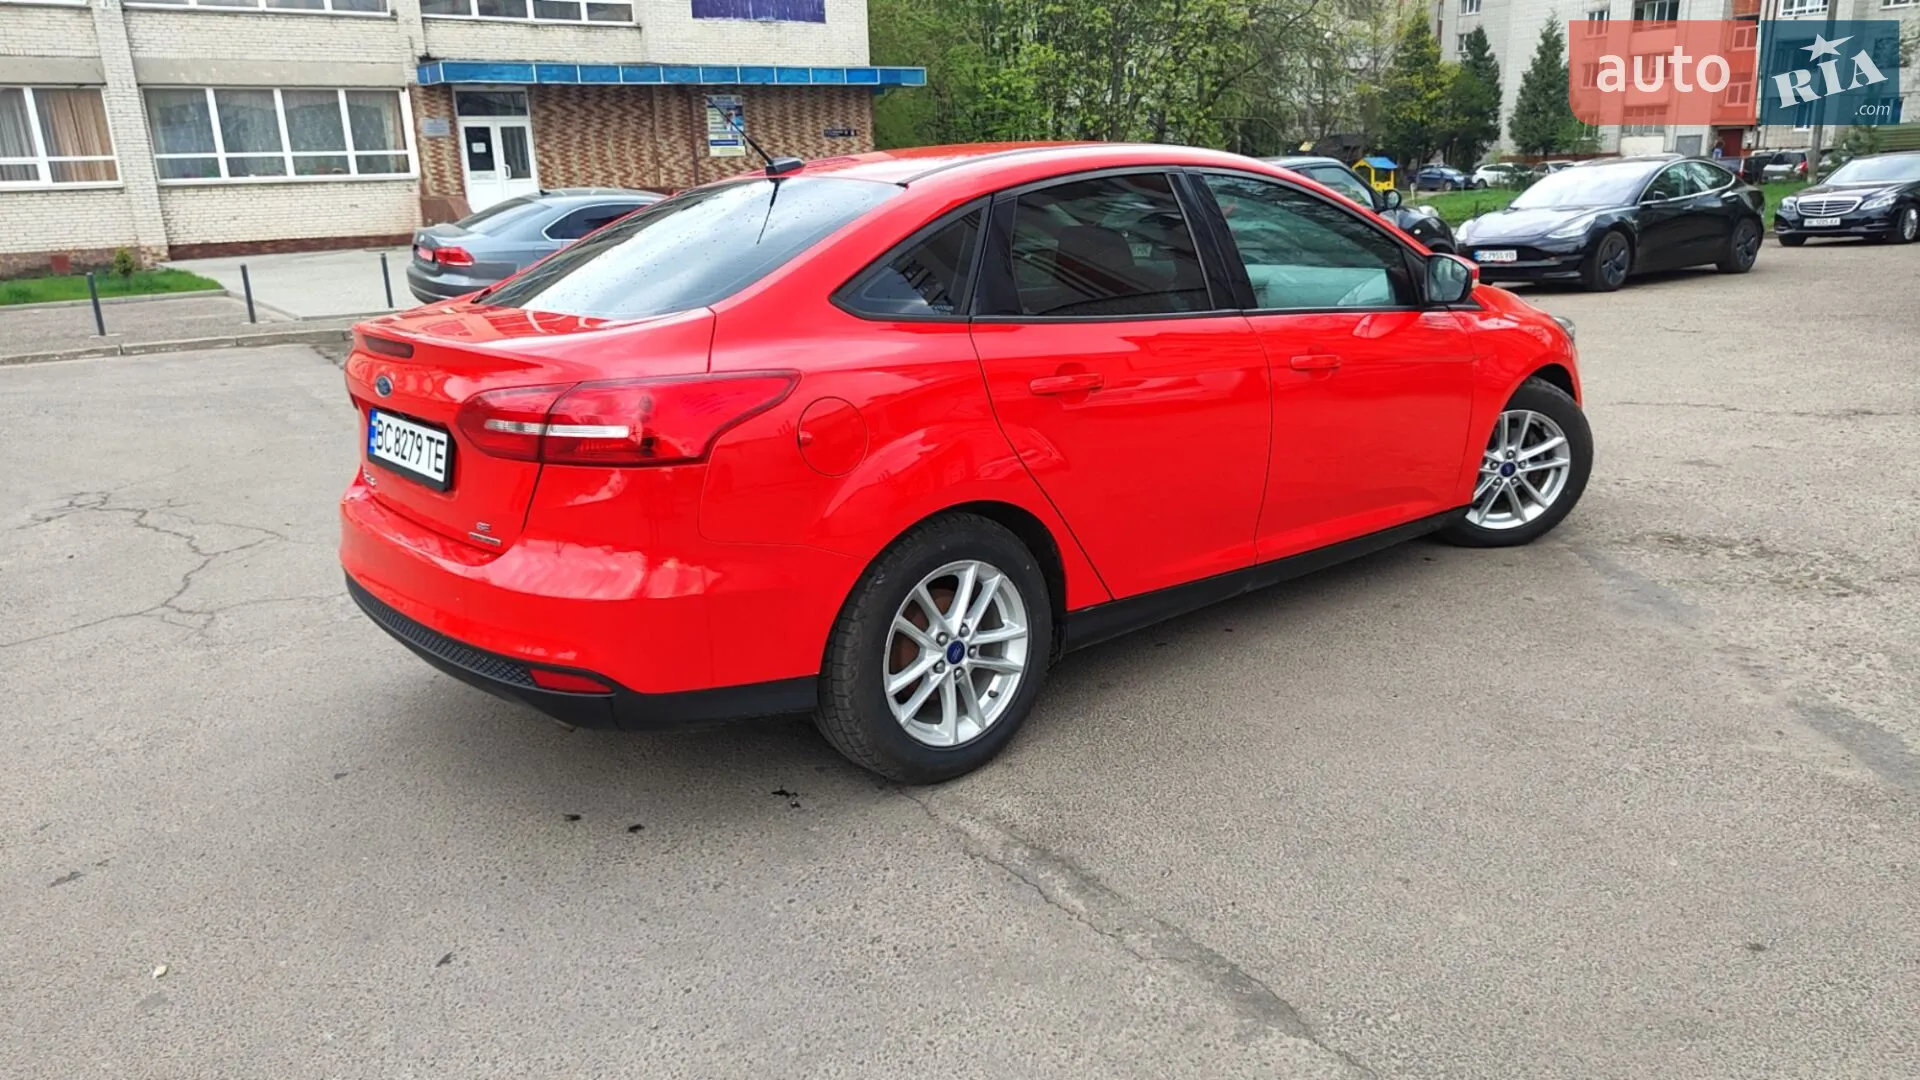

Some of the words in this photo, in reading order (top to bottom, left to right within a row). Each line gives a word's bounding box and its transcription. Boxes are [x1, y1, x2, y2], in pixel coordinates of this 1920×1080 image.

[376, 419, 393, 453] BC
[394, 426, 423, 465] 8279
[426, 436, 445, 474] TE
